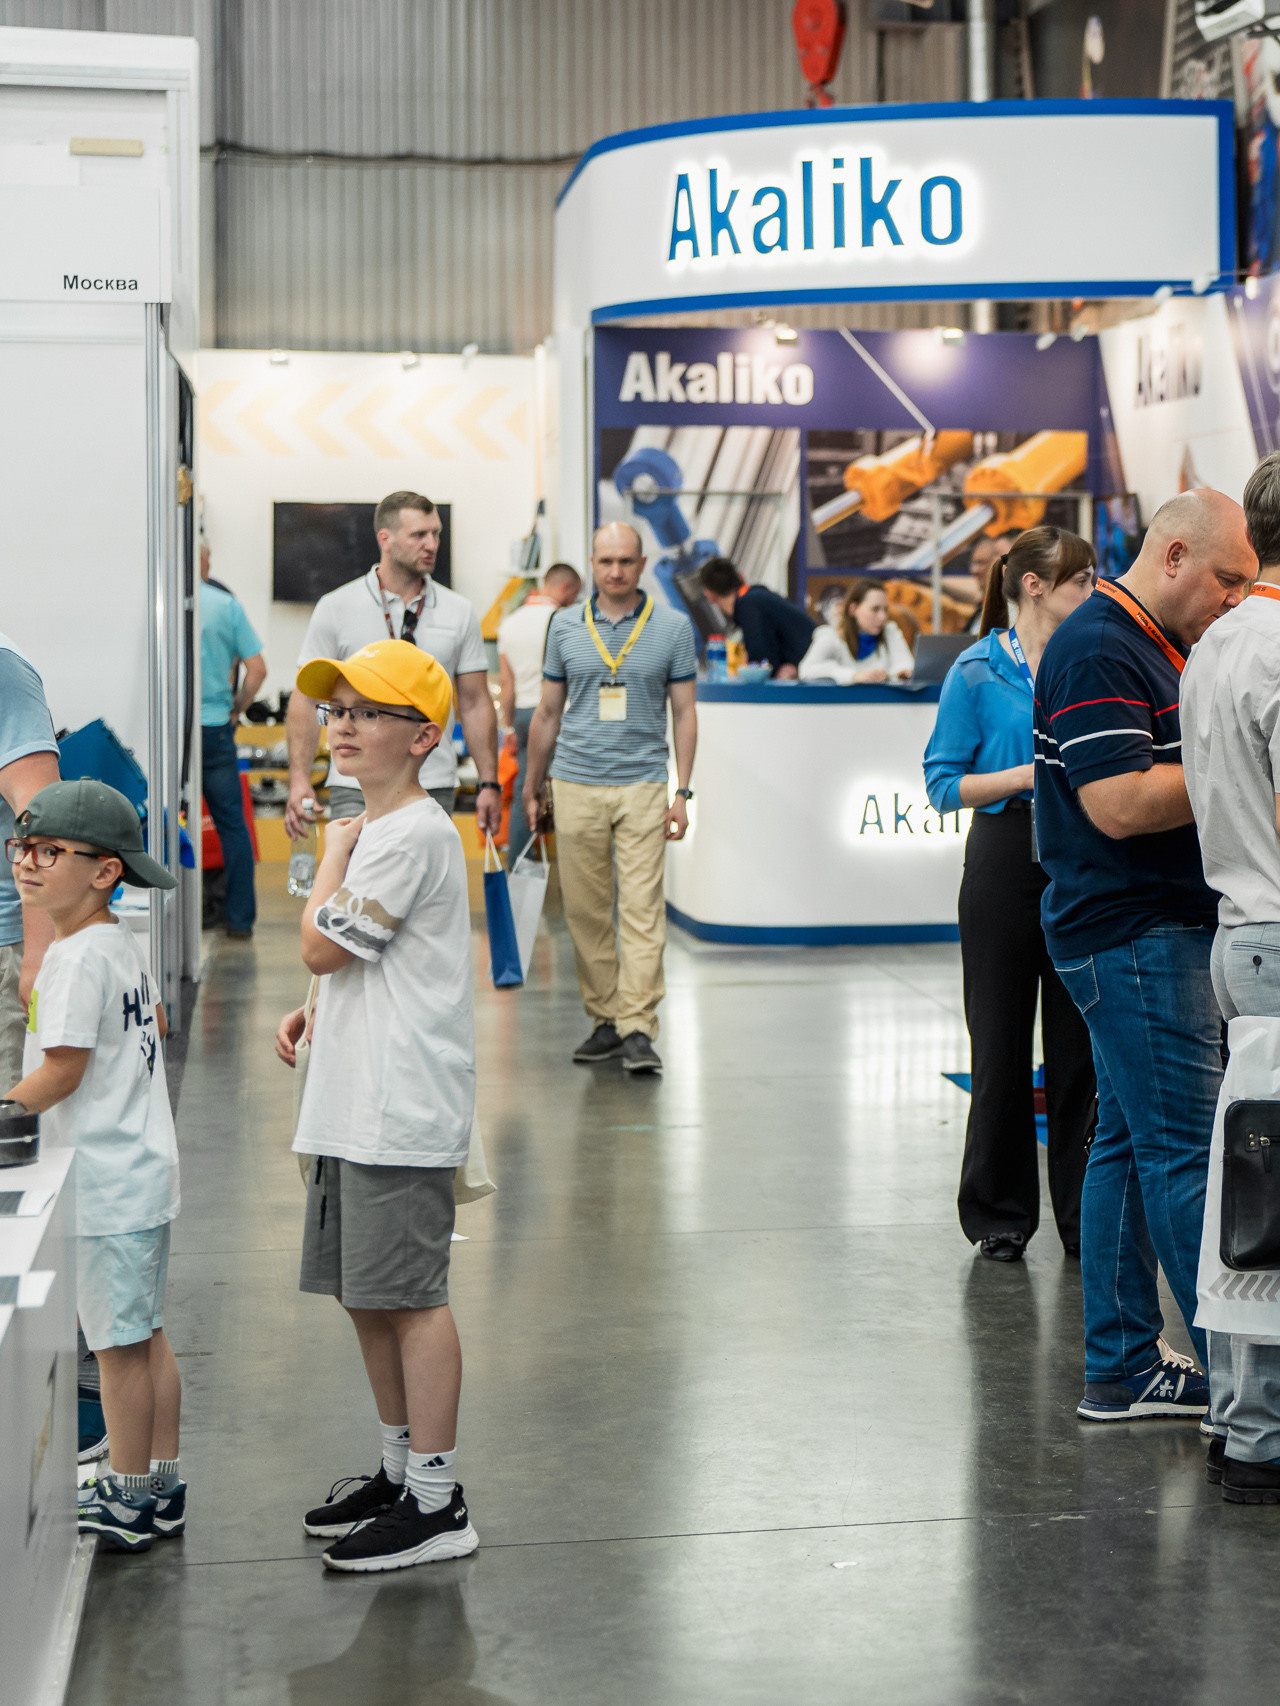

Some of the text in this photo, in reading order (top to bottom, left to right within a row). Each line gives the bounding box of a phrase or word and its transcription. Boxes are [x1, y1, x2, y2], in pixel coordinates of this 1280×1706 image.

[667, 156, 963, 261] Akaliko
[63, 274, 138, 290] Москва
[618, 351, 814, 406] Akaliko
